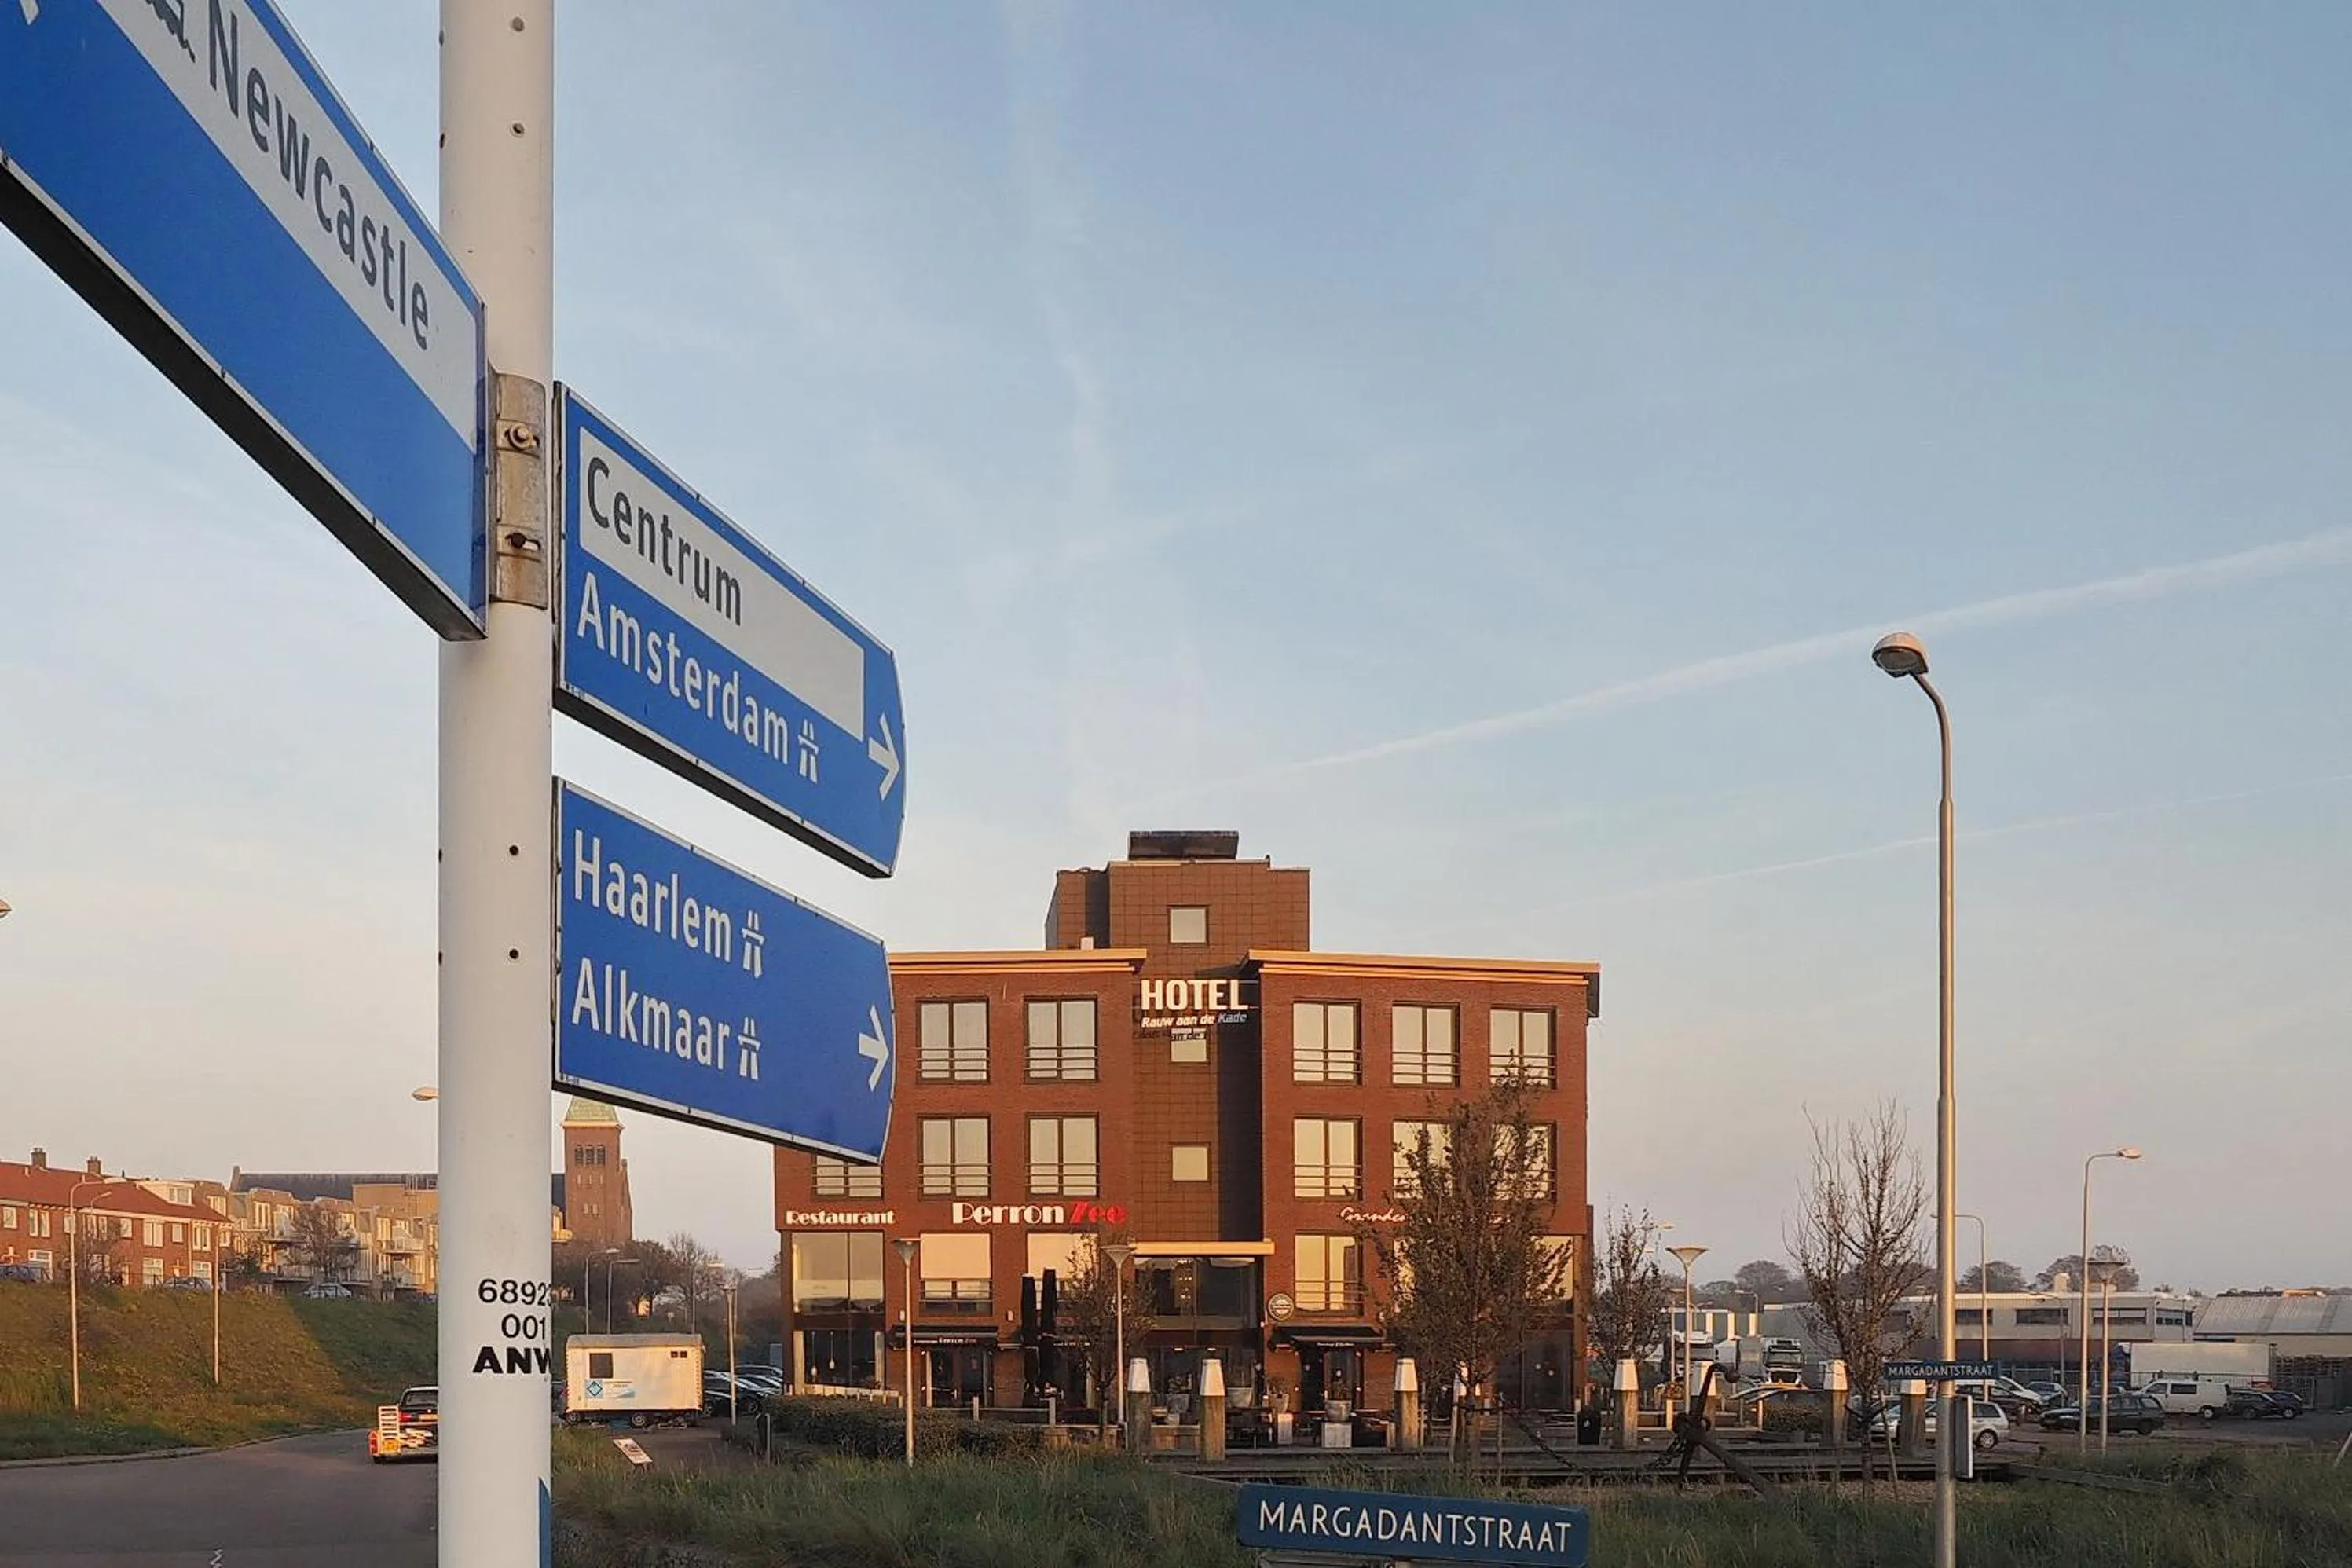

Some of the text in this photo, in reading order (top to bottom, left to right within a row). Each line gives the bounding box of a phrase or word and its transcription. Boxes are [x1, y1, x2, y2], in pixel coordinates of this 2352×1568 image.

[208, 0, 428, 350] Newcastle
[587, 456, 742, 627] Centrum
[577, 571, 789, 766] Amsterdam
[573, 828, 731, 963] Haarlem
[571, 957, 731, 1071] Alkmaar
[1141, 979, 1249, 1010] HOTEL
[1176, 1015, 1197, 1026] aan
[1200, 1013, 1216, 1025] de
[786, 1210, 896, 1225] Restaurant
[952, 1200, 1127, 1225] Perron Zee
[501, 1313, 546, 1340] 001
[1888, 1365, 1993, 1376] MARGADANTSTRAAT
[1259, 1500, 1572, 1553] MARGADANTSTRAAT
